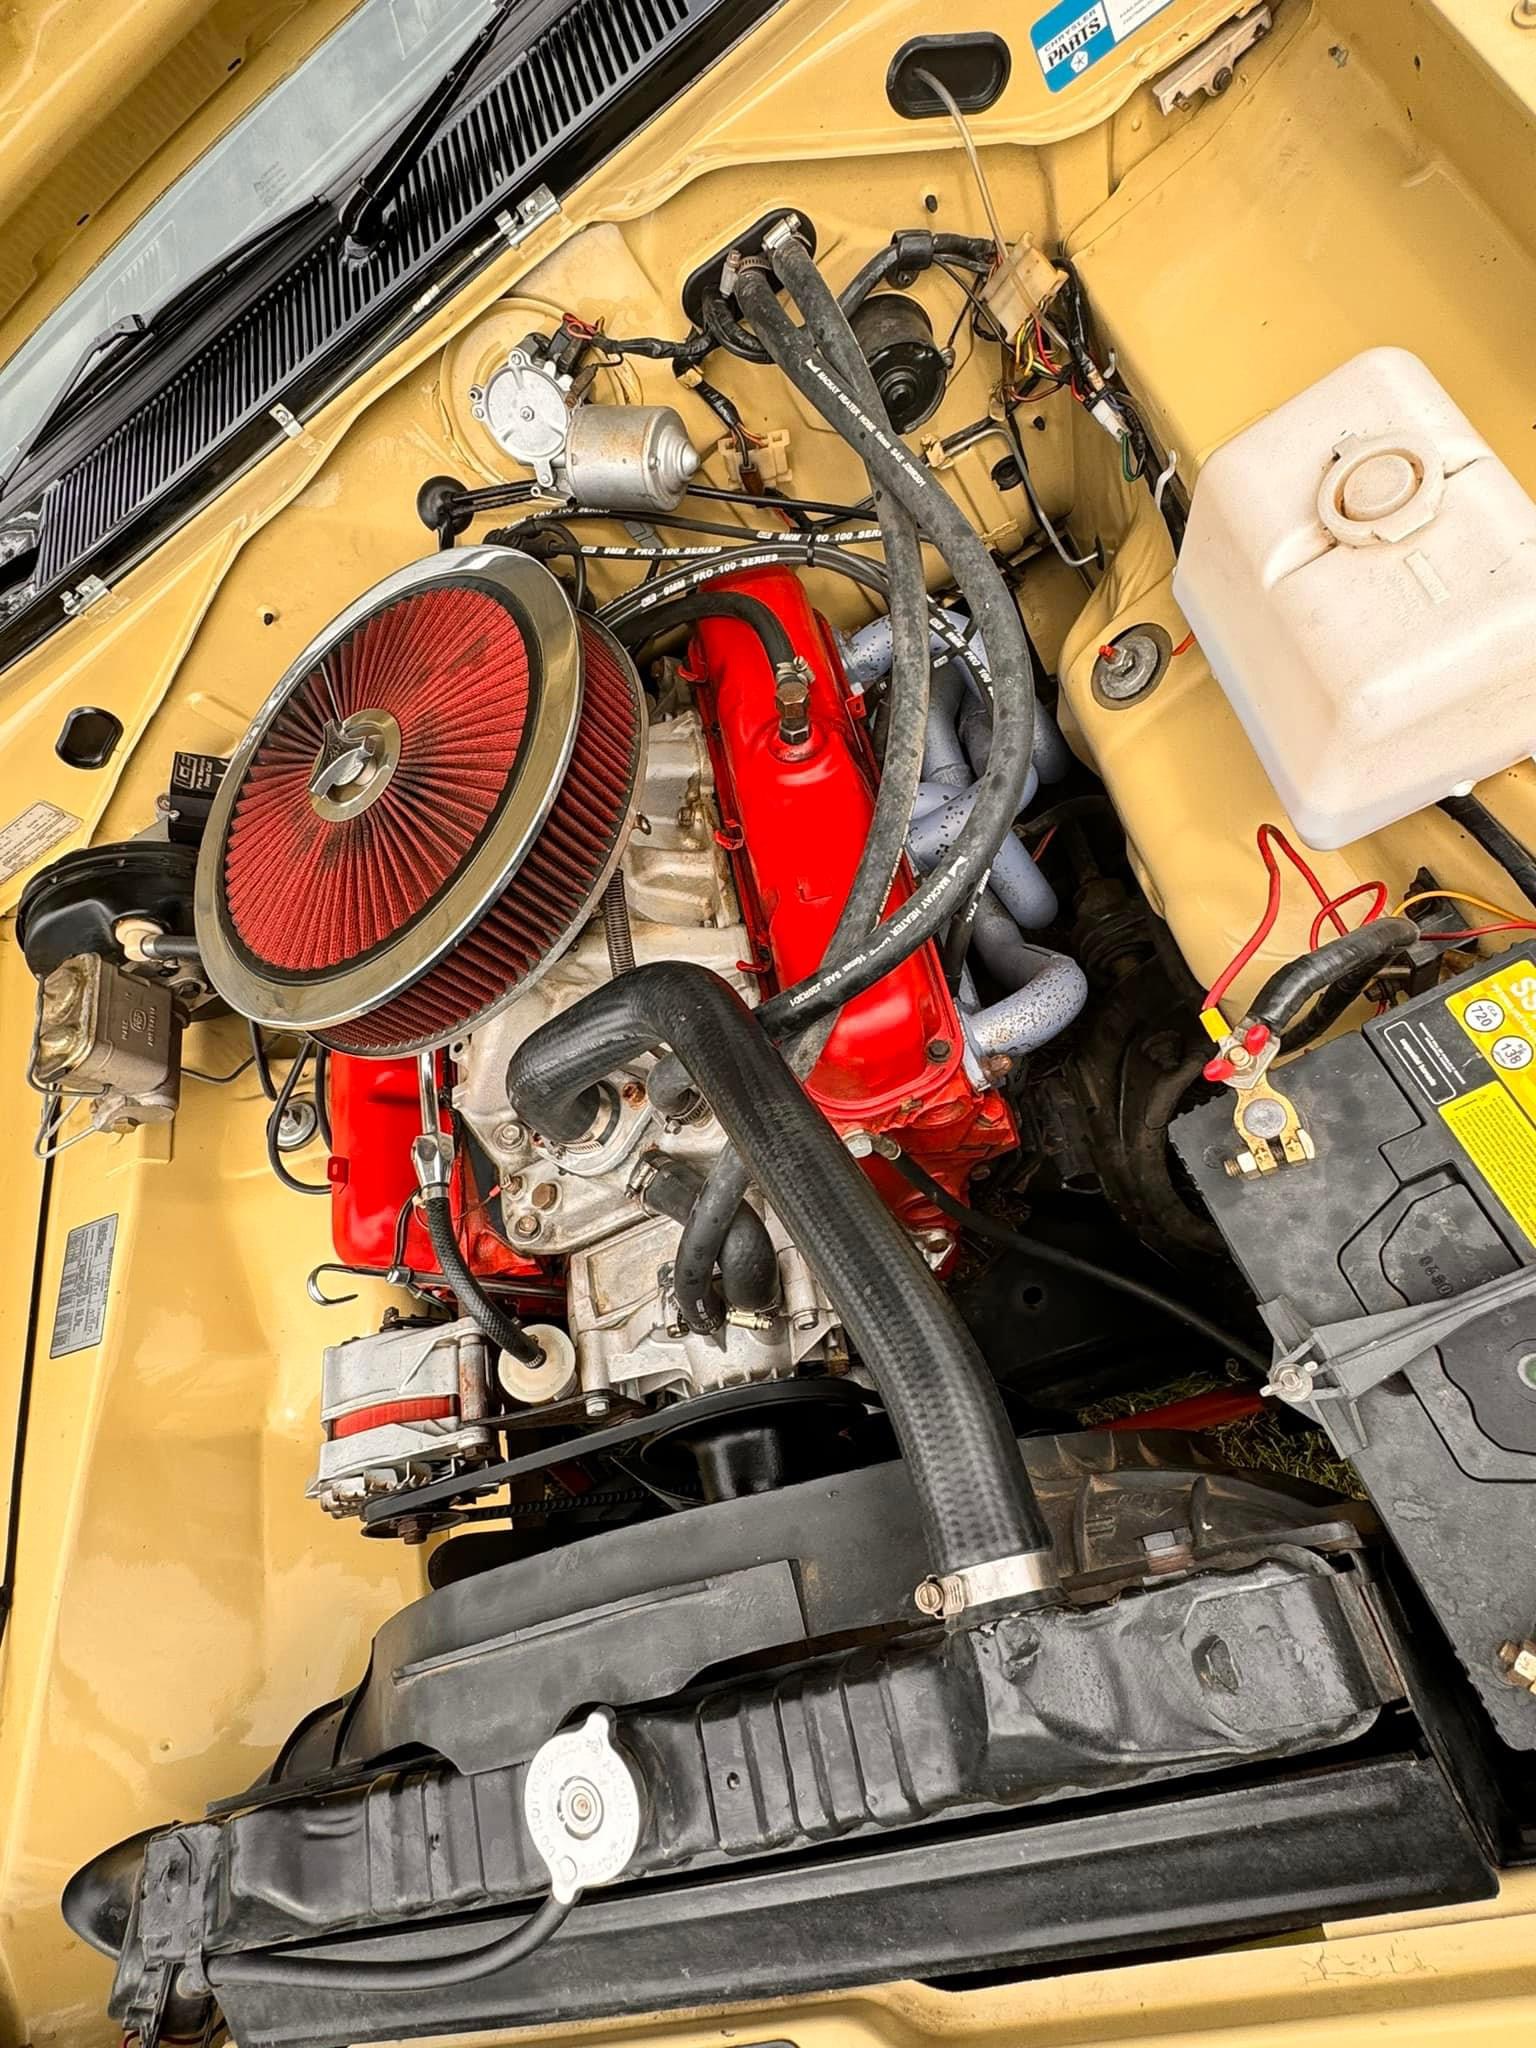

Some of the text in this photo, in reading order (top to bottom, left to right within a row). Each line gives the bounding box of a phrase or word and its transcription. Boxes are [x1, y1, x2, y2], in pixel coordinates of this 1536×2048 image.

[1044, 8, 1097, 52] CHRYSLER
[1046, 17, 1101, 68] PARTS
[817, 371, 842, 395] MACKAY
[838, 391, 861, 417] HEATER
[890, 447, 906, 463] SAE
[834, 532, 853, 541] 100
[633, 548, 657, 556] PRO
[661, 547, 680, 555] 100
[684, 546, 722, 555] SERIES
[692, 568, 714, 584] PRO
[718, 561, 737, 575] 100
[741, 553, 779, 567] SERIES
[920, 876, 951, 910] MACKAY
[890, 907, 922, 937] HEATER
[842, 954, 867, 973] 16mm
[823, 970, 843, 987] SAE
[1471, 1005, 1493, 1028] 720
[1500, 1042, 1523, 1065] 138
